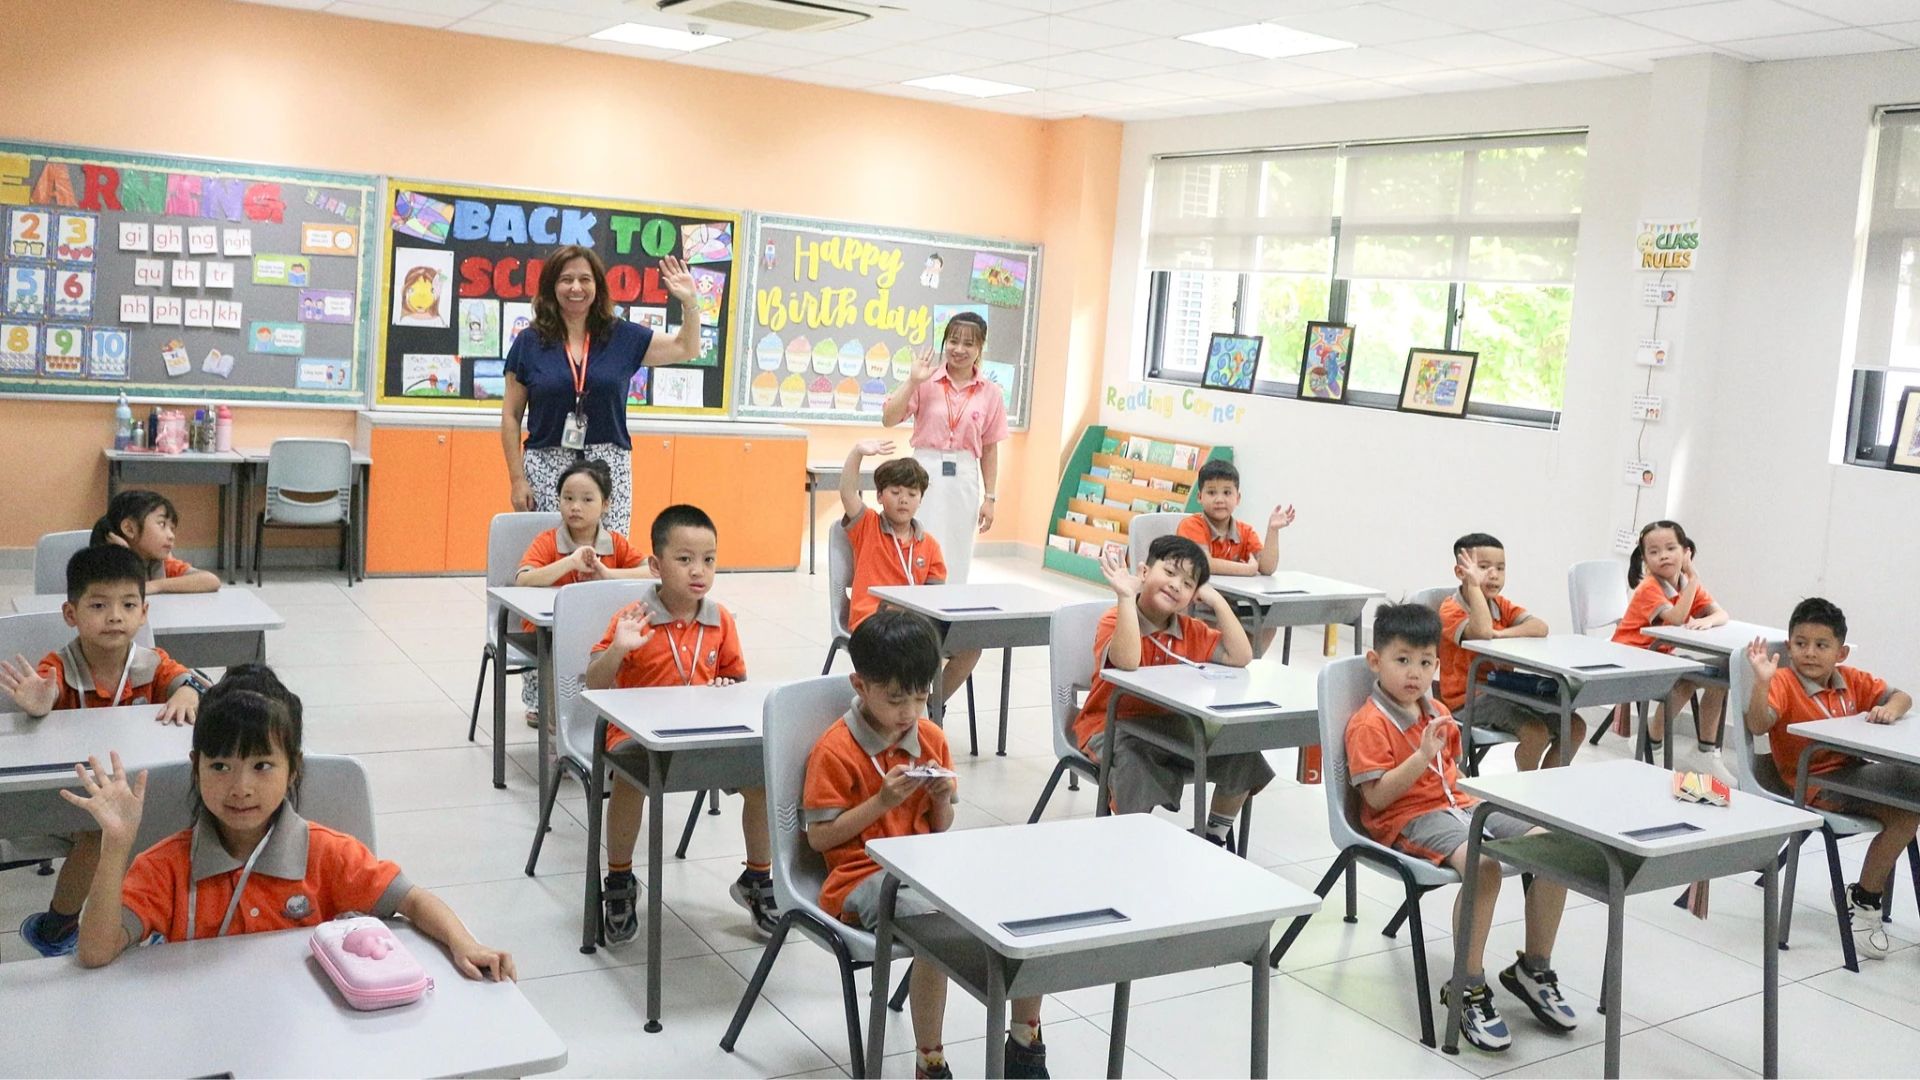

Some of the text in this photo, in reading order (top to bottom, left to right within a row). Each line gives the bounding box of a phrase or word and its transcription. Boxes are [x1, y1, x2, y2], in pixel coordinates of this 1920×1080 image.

[20, 213, 40, 240] 2
[66, 218, 87, 244] 3
[125, 226, 250, 250] gi gh ng ngh
[453, 200, 676, 257] BACK TO
[1656, 233, 1699, 249] CLASS
[794, 235, 904, 289] Happy
[1642, 251, 1691, 268] RULES
[16, 269, 38, 296] 5
[64, 273, 83, 298] 6
[137, 264, 226, 283] qu th tr
[459, 256, 669, 304] SCOL
[124, 299, 238, 321] nh ph ch kh
[7, 327, 29, 352] 8
[55, 329, 73, 355] 9
[95, 333, 124, 358] 10
[1106, 384, 1246, 423] Reading Corner
